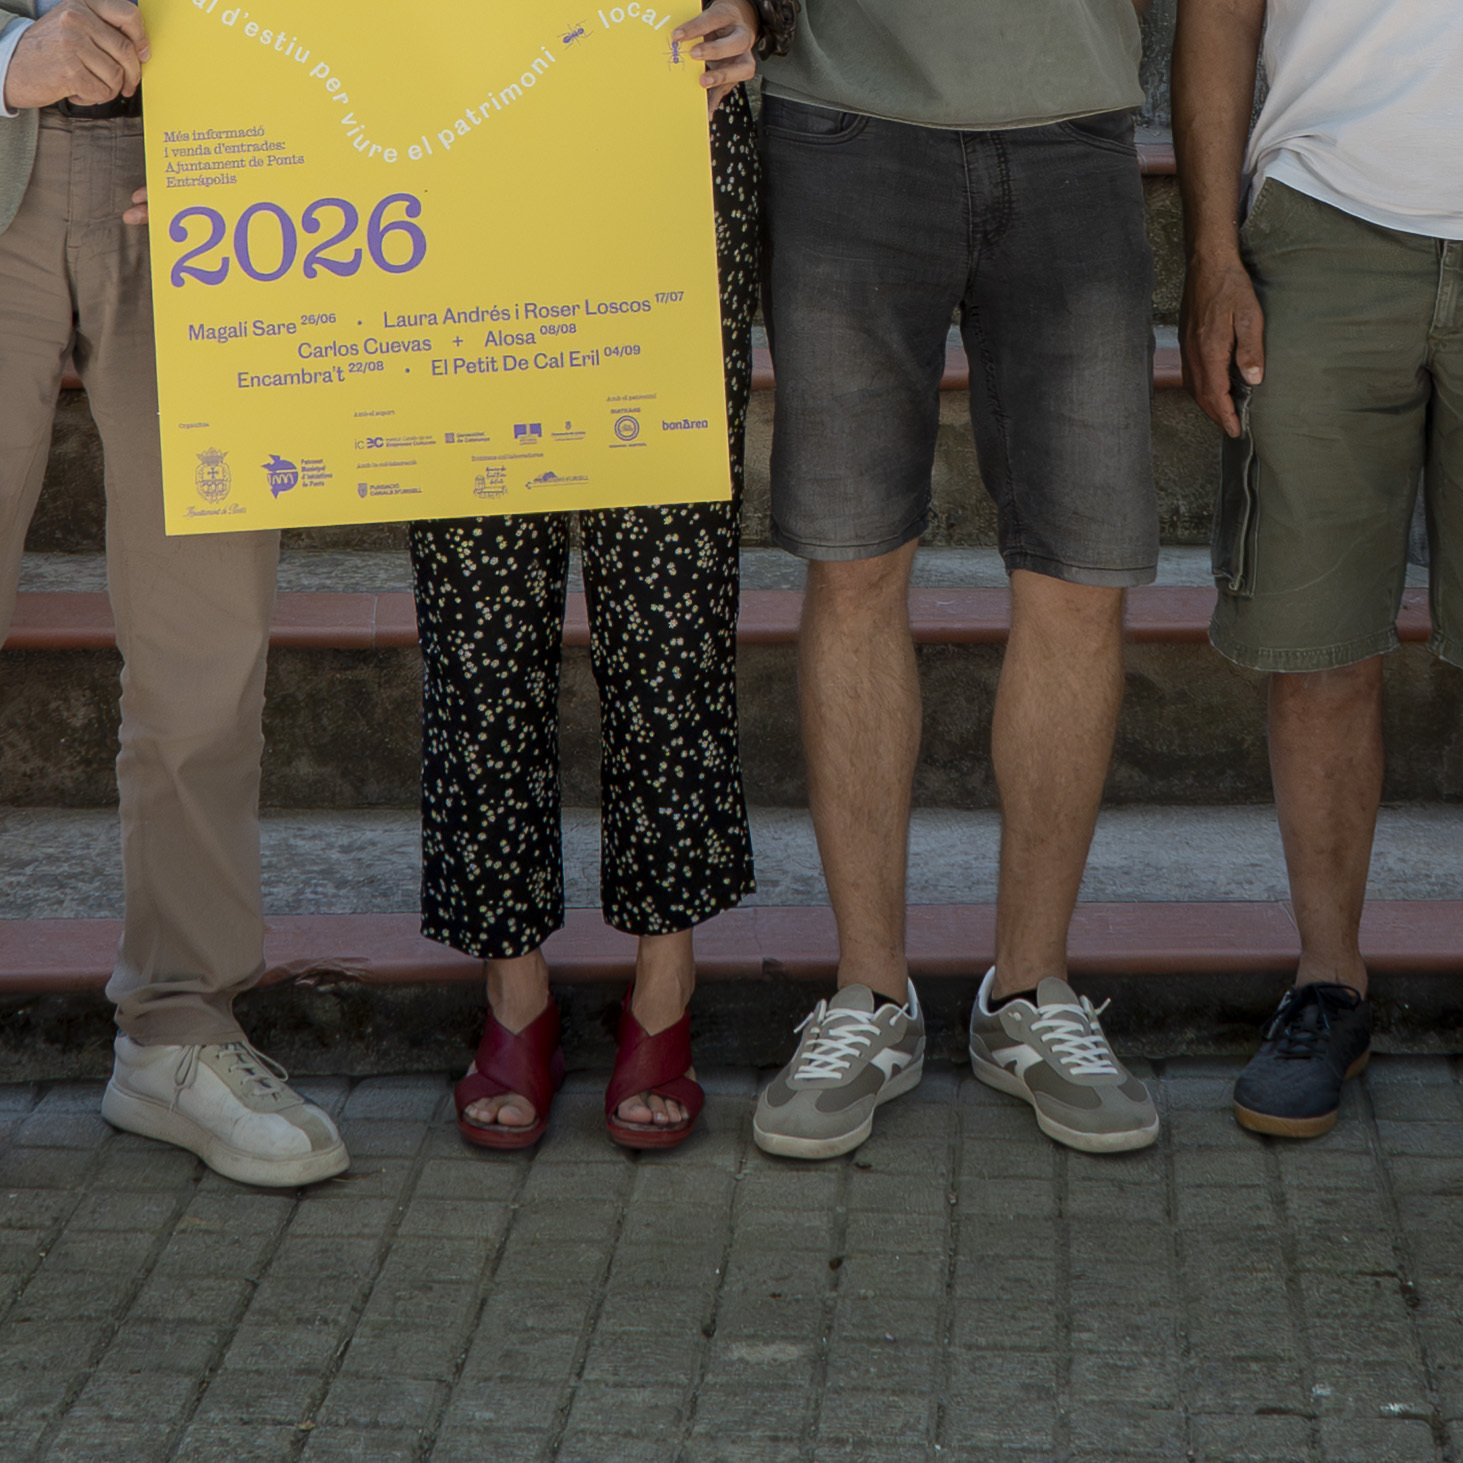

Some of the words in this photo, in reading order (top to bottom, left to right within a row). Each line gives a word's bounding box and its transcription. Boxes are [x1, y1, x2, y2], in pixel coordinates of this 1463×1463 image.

[309, 61, 349, 105] per
[340, 112, 398, 163] viure
[407, 135, 433, 161] el
[437, 45, 556, 151] patrimoni
[597, 1, 672, 31] local
[163, 130, 190, 143] Més
[192, 125, 265, 141] informació
[171, 144, 212, 157] venda
[165, 158, 246, 174] Ajuntament
[248, 156, 264, 168] de
[267, 154, 305, 166] Ponts
[168, 192, 427, 289] 2026
[252, 320, 297, 336] Sare
[300, 313, 337, 326] 26/06
[384, 310, 438, 328] Laura
[443, 305, 511, 324] Andrés
[515, 303, 520, 320] i
[524, 301, 581, 318] Roser
[585, 299, 652, 316] Loscos
[654, 291, 685, 304] 17/07
[297, 340, 360, 359] Carlos
[363, 337, 432, 355] Cuevas
[484, 330, 537, 347] Alosa
[539, 323, 577, 337] 08/08
[237, 365, 346, 388] Encambra't
[348, 360, 384, 374] 22/08
[431, 358, 448, 376] El
[453, 356, 499, 375] Petit
[503, 354, 530, 372] De
[533, 351, 564, 370] Cal
[569, 349, 600, 368] Eril
[603, 344, 641, 358] 04/09
